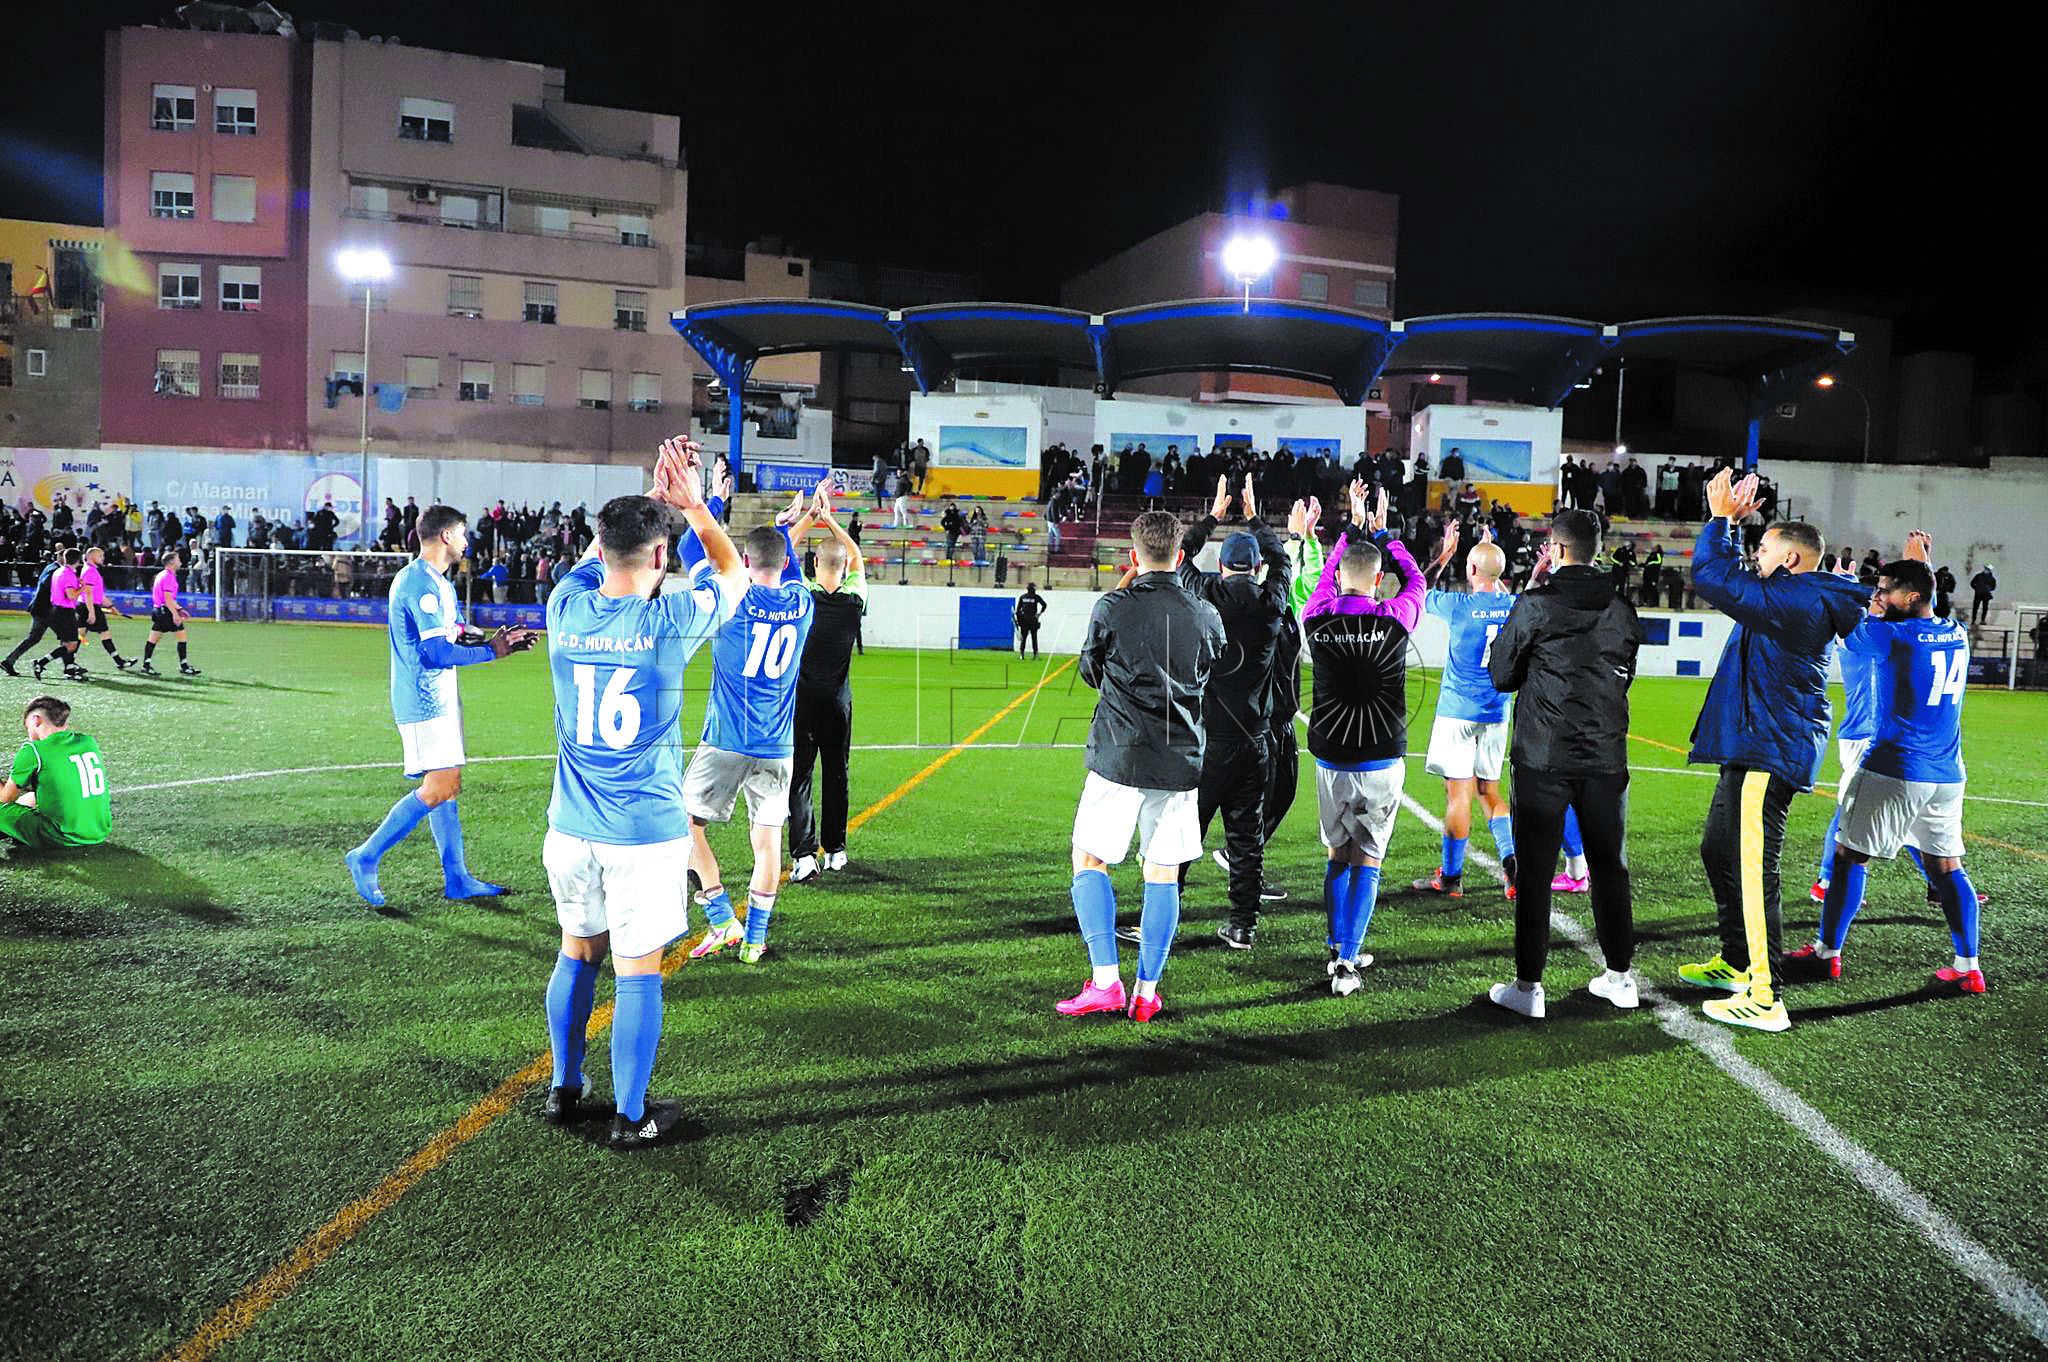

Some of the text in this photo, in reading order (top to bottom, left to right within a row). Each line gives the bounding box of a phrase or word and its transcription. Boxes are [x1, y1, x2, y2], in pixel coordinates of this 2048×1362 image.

[61, 462, 99, 473] Melilla
[166, 480, 269, 500] C/ Maanan
[310, 497, 362, 513] LDL
[748, 605, 767, 619] C.D.
[1471, 610, 1489, 619] C.D.
[557, 631, 654, 652] C.D. HURACÁN
[1313, 630, 1385, 643] C.D. HURACÁN
[1480, 624, 1504, 668] 1
[741, 621, 798, 680] 10
[1926, 648, 1969, 706] 14
[573, 663, 641, 750] 16
[69, 751, 106, 799] 16
